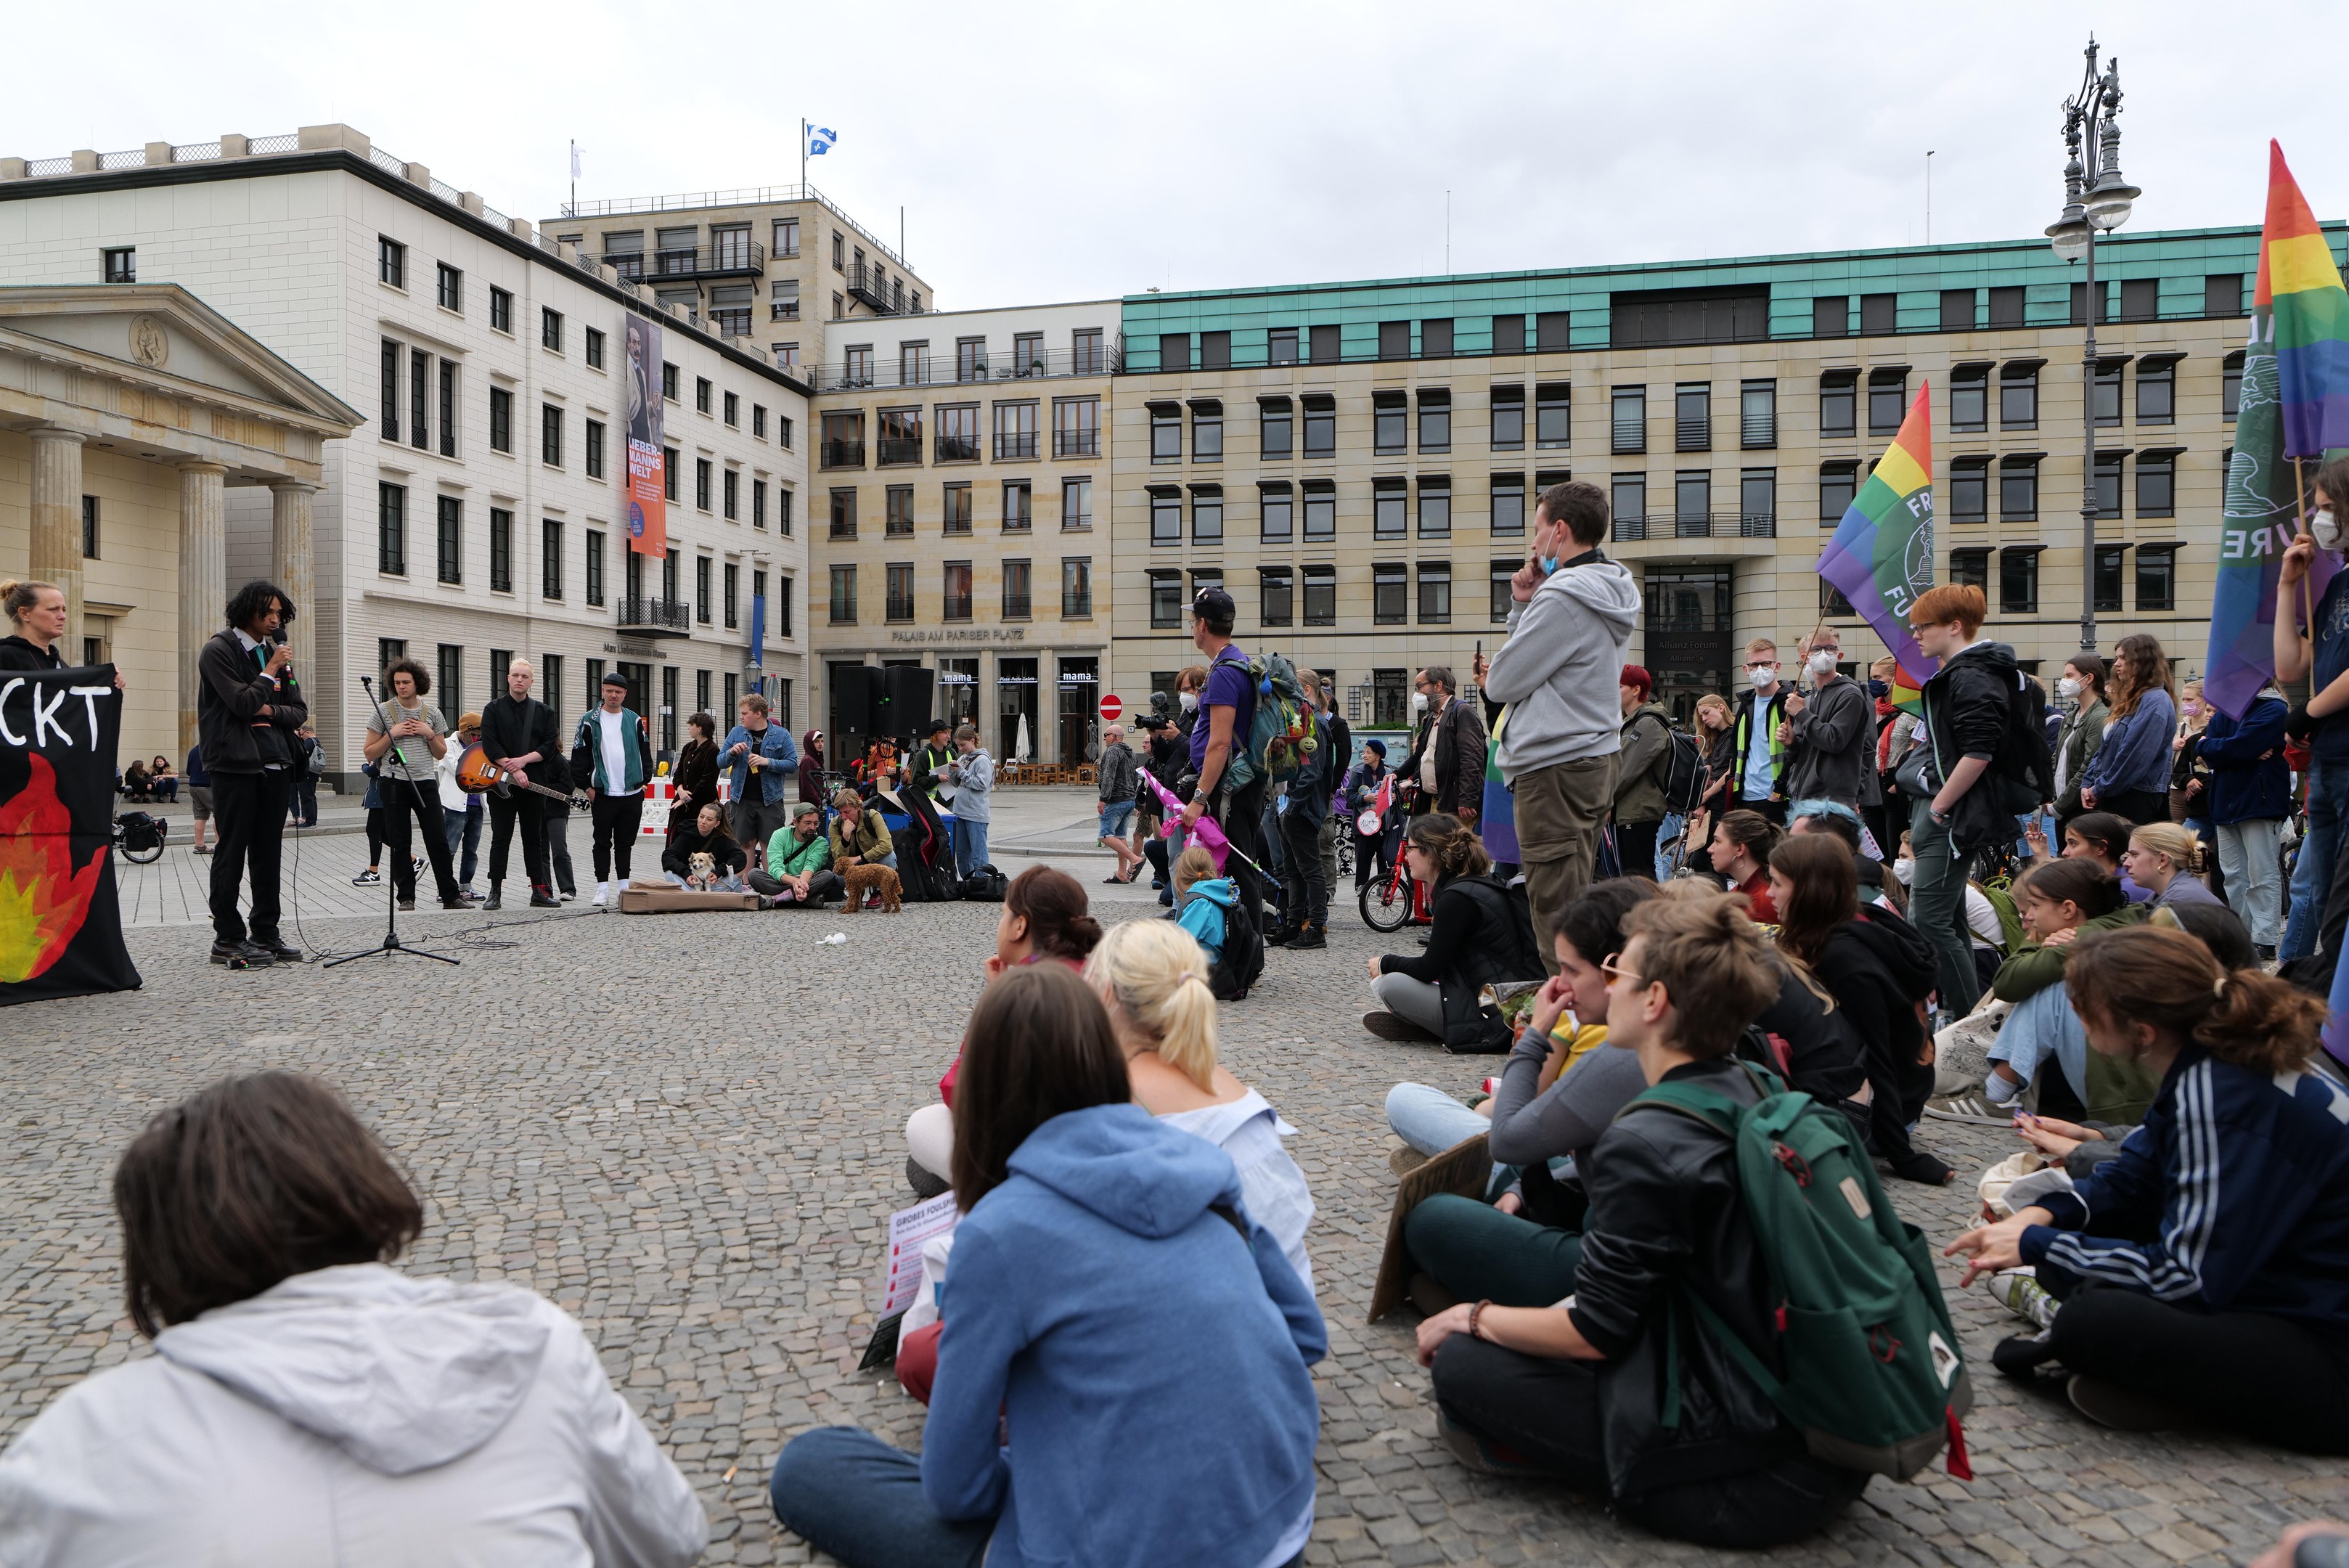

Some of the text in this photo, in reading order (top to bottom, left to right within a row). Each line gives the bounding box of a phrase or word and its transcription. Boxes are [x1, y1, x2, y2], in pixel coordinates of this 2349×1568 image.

[629, 436, 661, 457] LIEBER-
[630, 462, 652, 479] WELT
[892, 627, 1024, 642] PALAIS AM PARISER PLATZ
[603, 643, 616, 653] Max
[618, 645, 652, 657] Liebermann
[0, 677, 112, 752] CKT
[896, 1209, 926, 1227] GROBES
